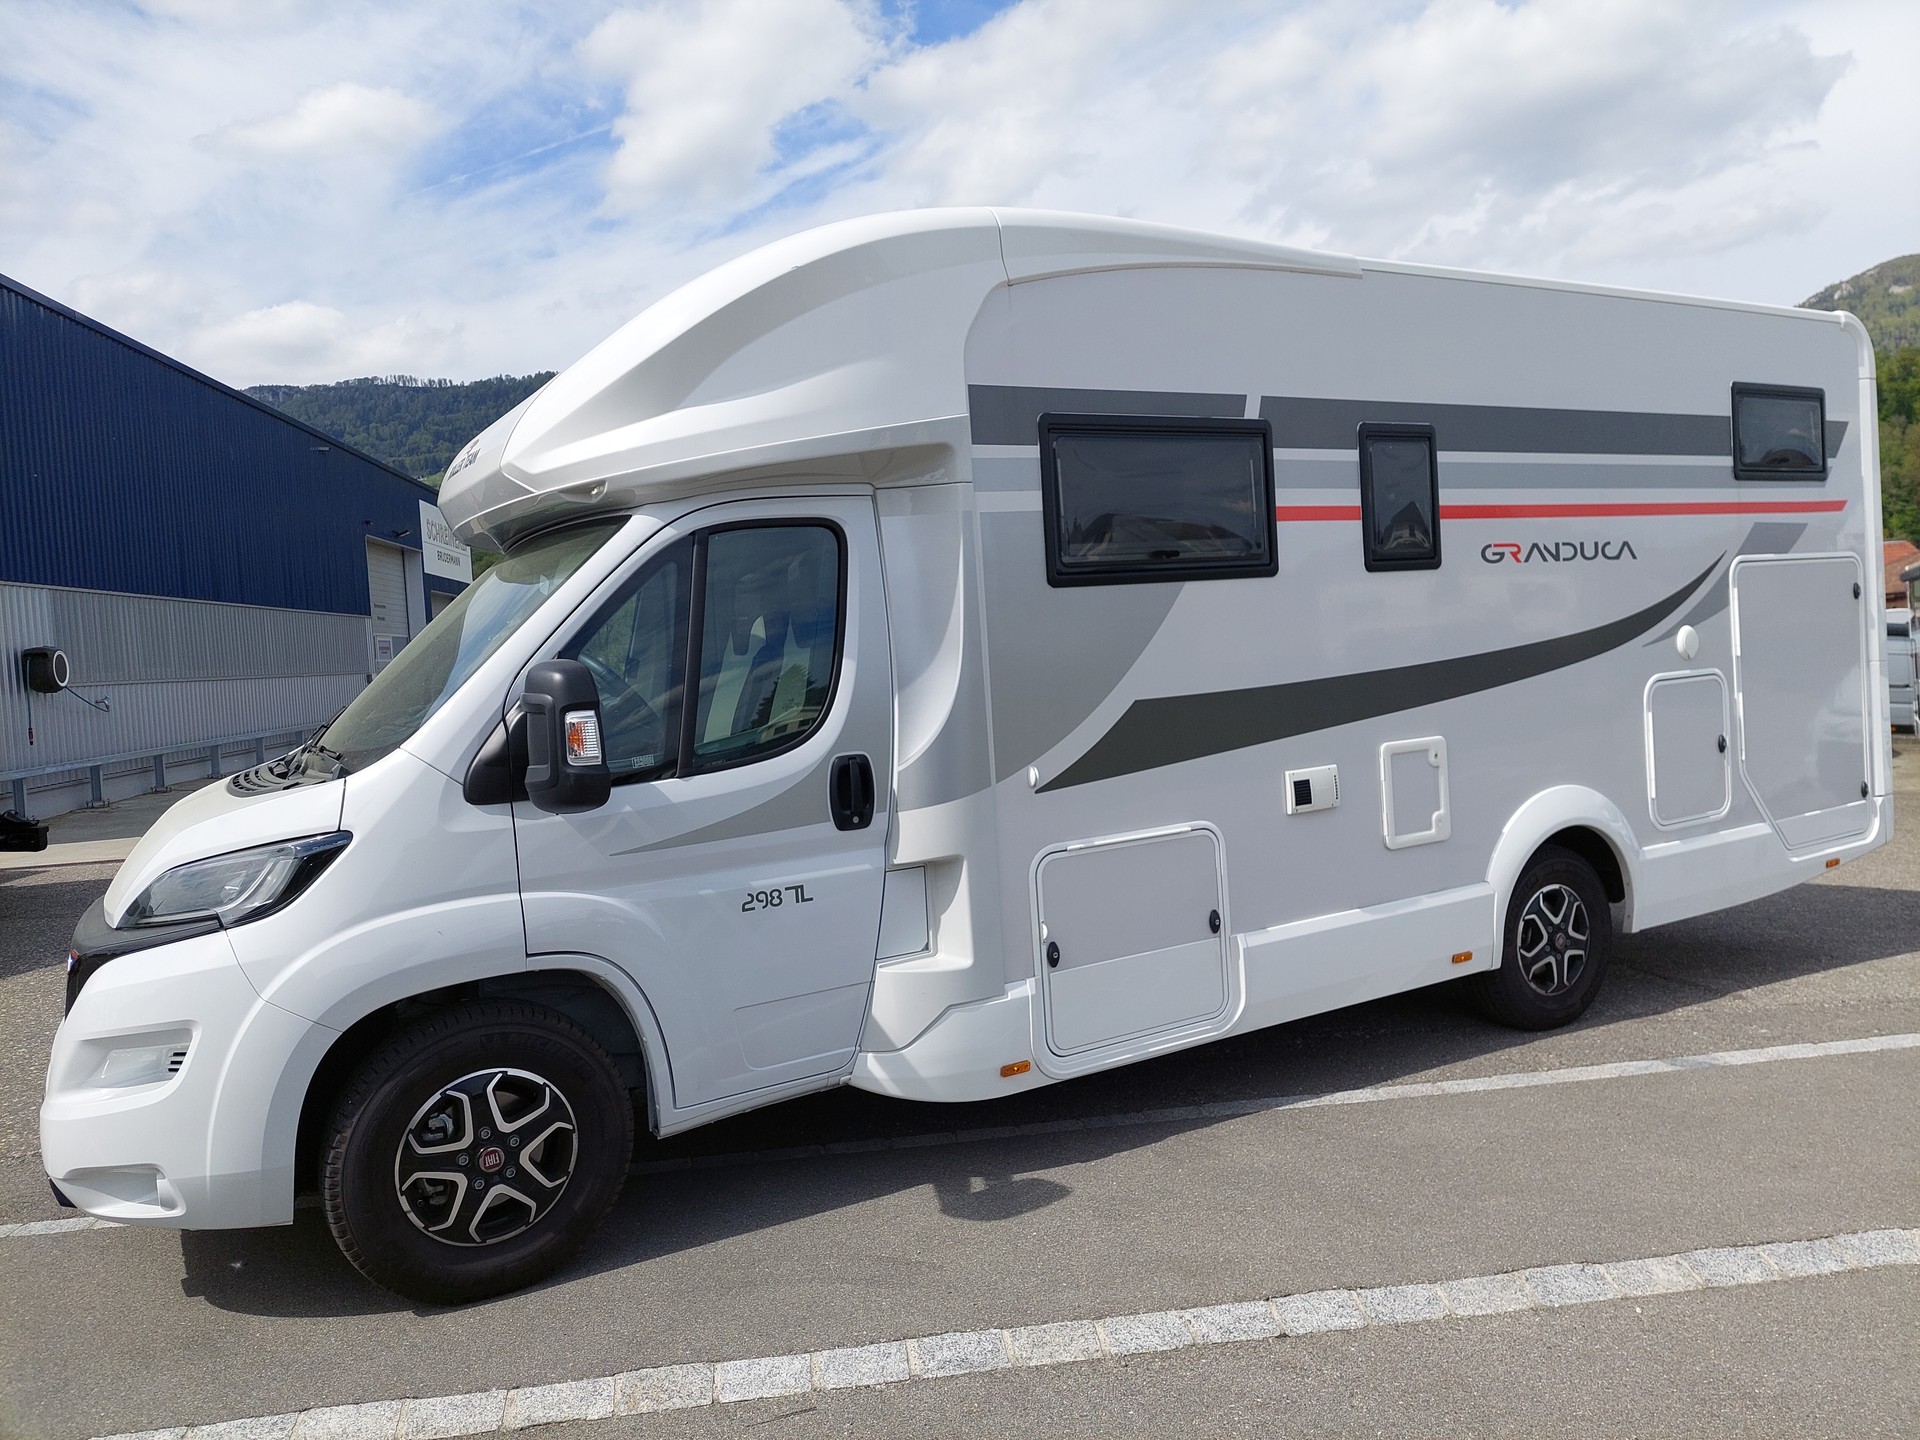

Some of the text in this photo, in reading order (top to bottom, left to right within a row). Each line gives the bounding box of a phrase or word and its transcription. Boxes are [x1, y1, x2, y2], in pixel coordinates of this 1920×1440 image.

[1480, 540, 1638, 564] GRANDUCA
[741, 884, 814, 913] 298 TL
[484, 1152, 500, 1167] FIAT
